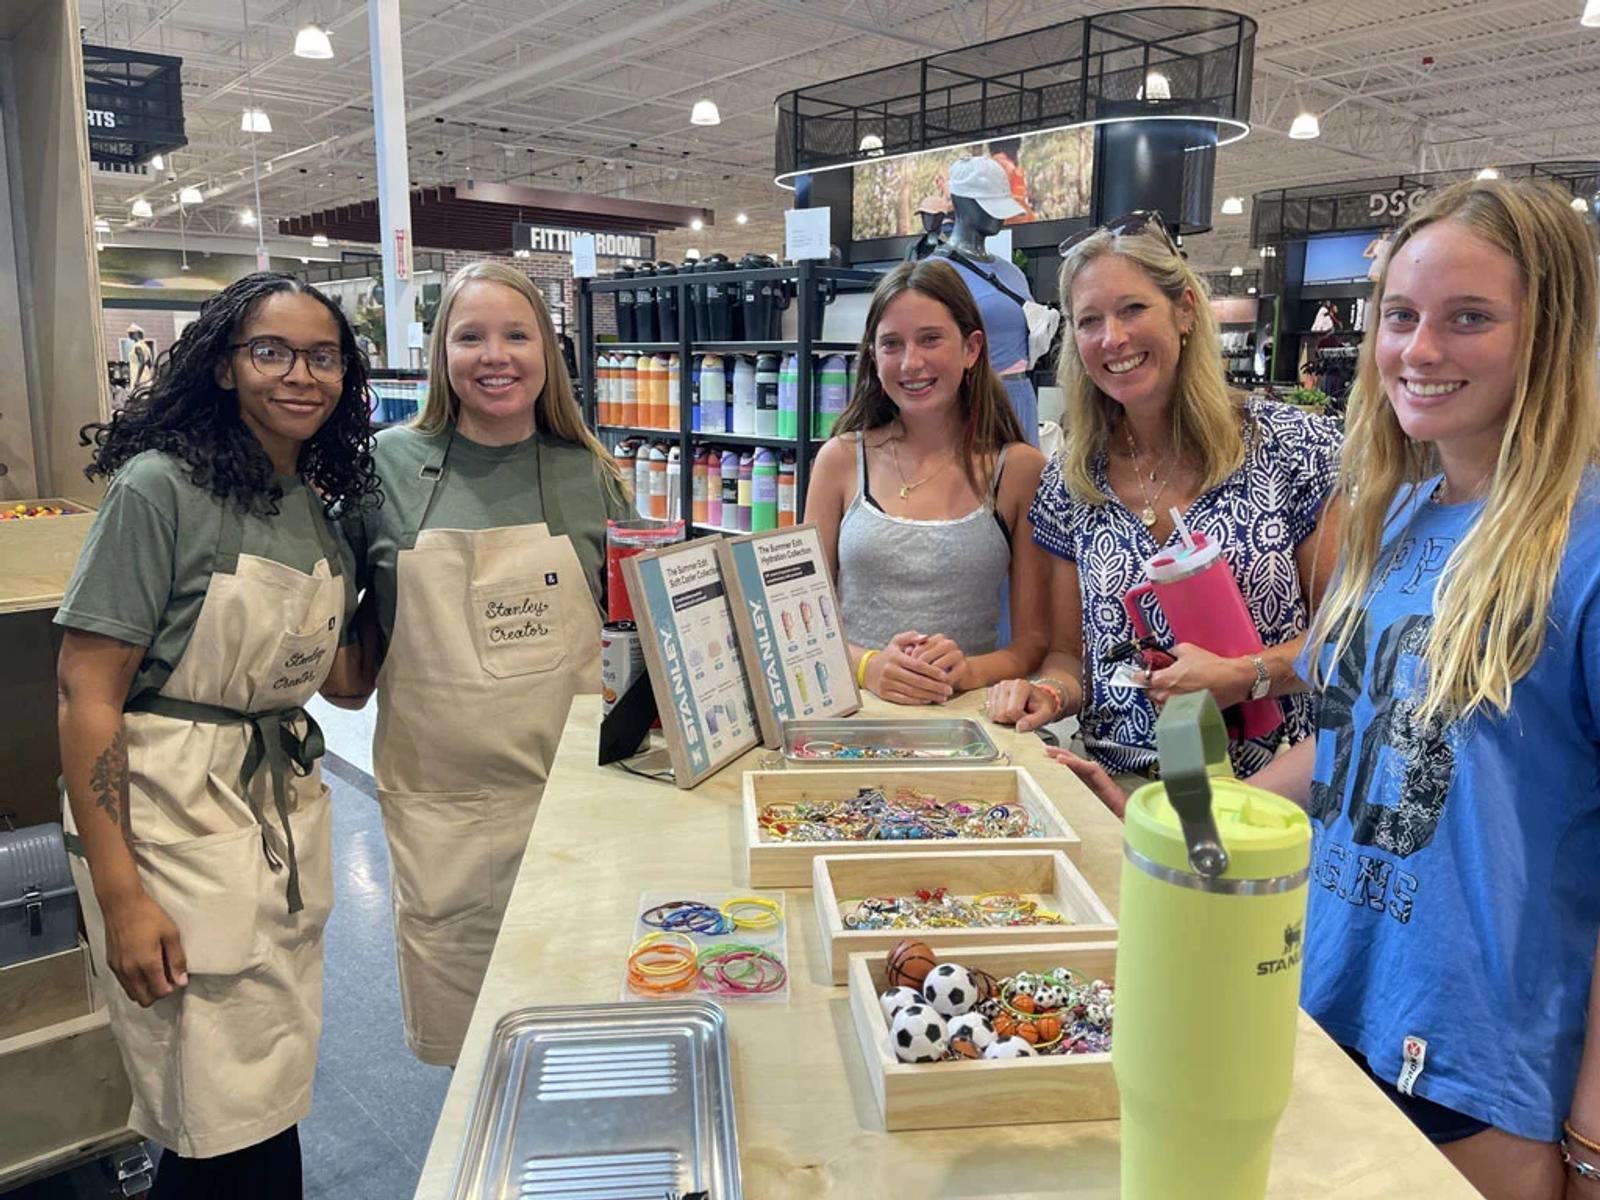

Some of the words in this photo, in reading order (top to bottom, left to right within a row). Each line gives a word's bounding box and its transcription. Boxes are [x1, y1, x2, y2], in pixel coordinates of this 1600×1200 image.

[530, 226, 594, 252] FITTI
[595, 233, 641, 257] ROOM
[786, 547, 812, 559] Collection
[485, 597, 549, 619] Stanley
[489, 621, 549, 642] Creator
[749, 600, 785, 706] STANLEY
[660, 629, 698, 745] STANLEY
